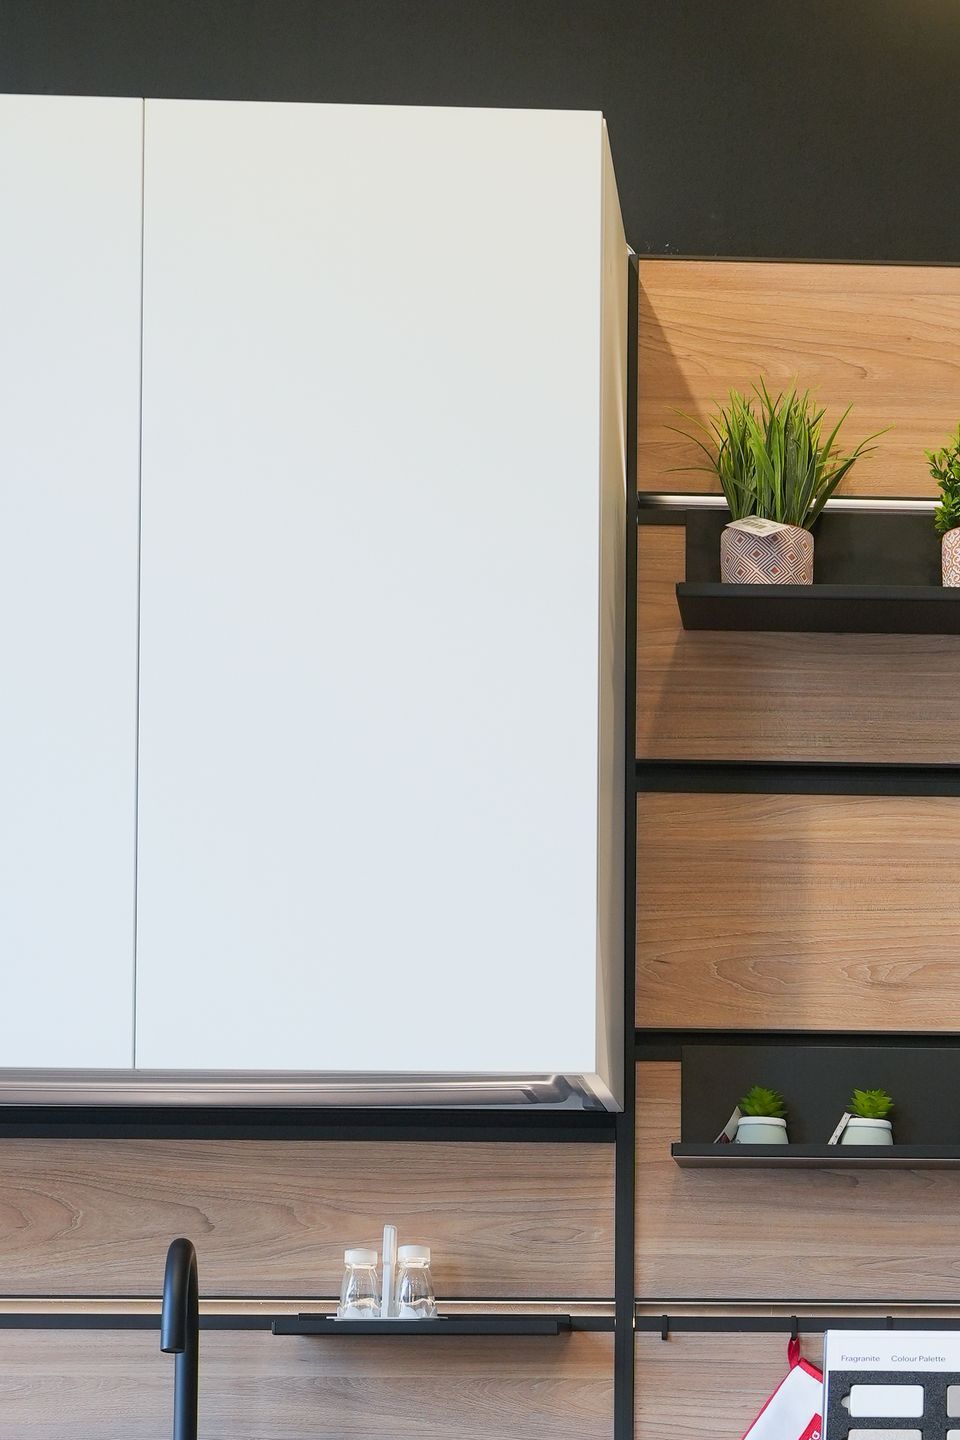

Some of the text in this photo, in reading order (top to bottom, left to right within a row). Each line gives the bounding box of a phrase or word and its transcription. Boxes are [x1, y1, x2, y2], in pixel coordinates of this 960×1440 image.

[841, 1354, 881, 1363] Fragranite
[891, 1354, 946, 1363] Colour Palette
